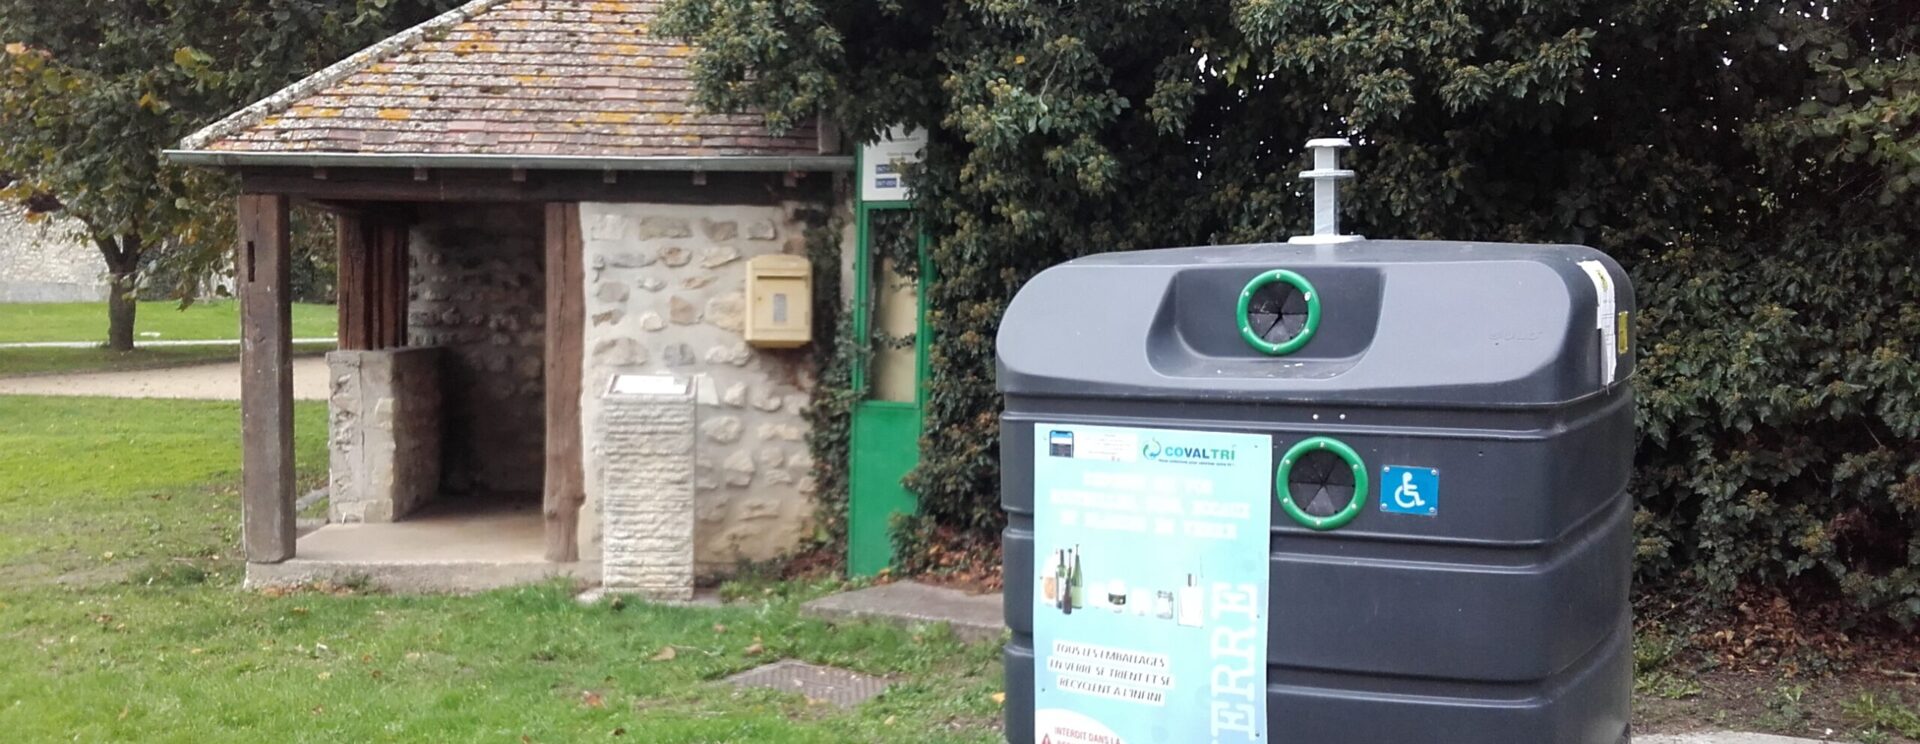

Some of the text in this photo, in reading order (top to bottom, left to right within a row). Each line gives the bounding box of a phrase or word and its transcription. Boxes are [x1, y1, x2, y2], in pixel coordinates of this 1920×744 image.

[1165, 446, 1235, 460] COVALTRI
[1210, 582, 1258, 744] ERRE
[1064, 662, 1091, 675] VERRE
[1110, 668, 1143, 683] TRIENT
[1059, 677, 1111, 695] RECYCLENT
[1054, 727, 1087, 741] INTERDIT
[1088, 733, 1109, 744] DANS
